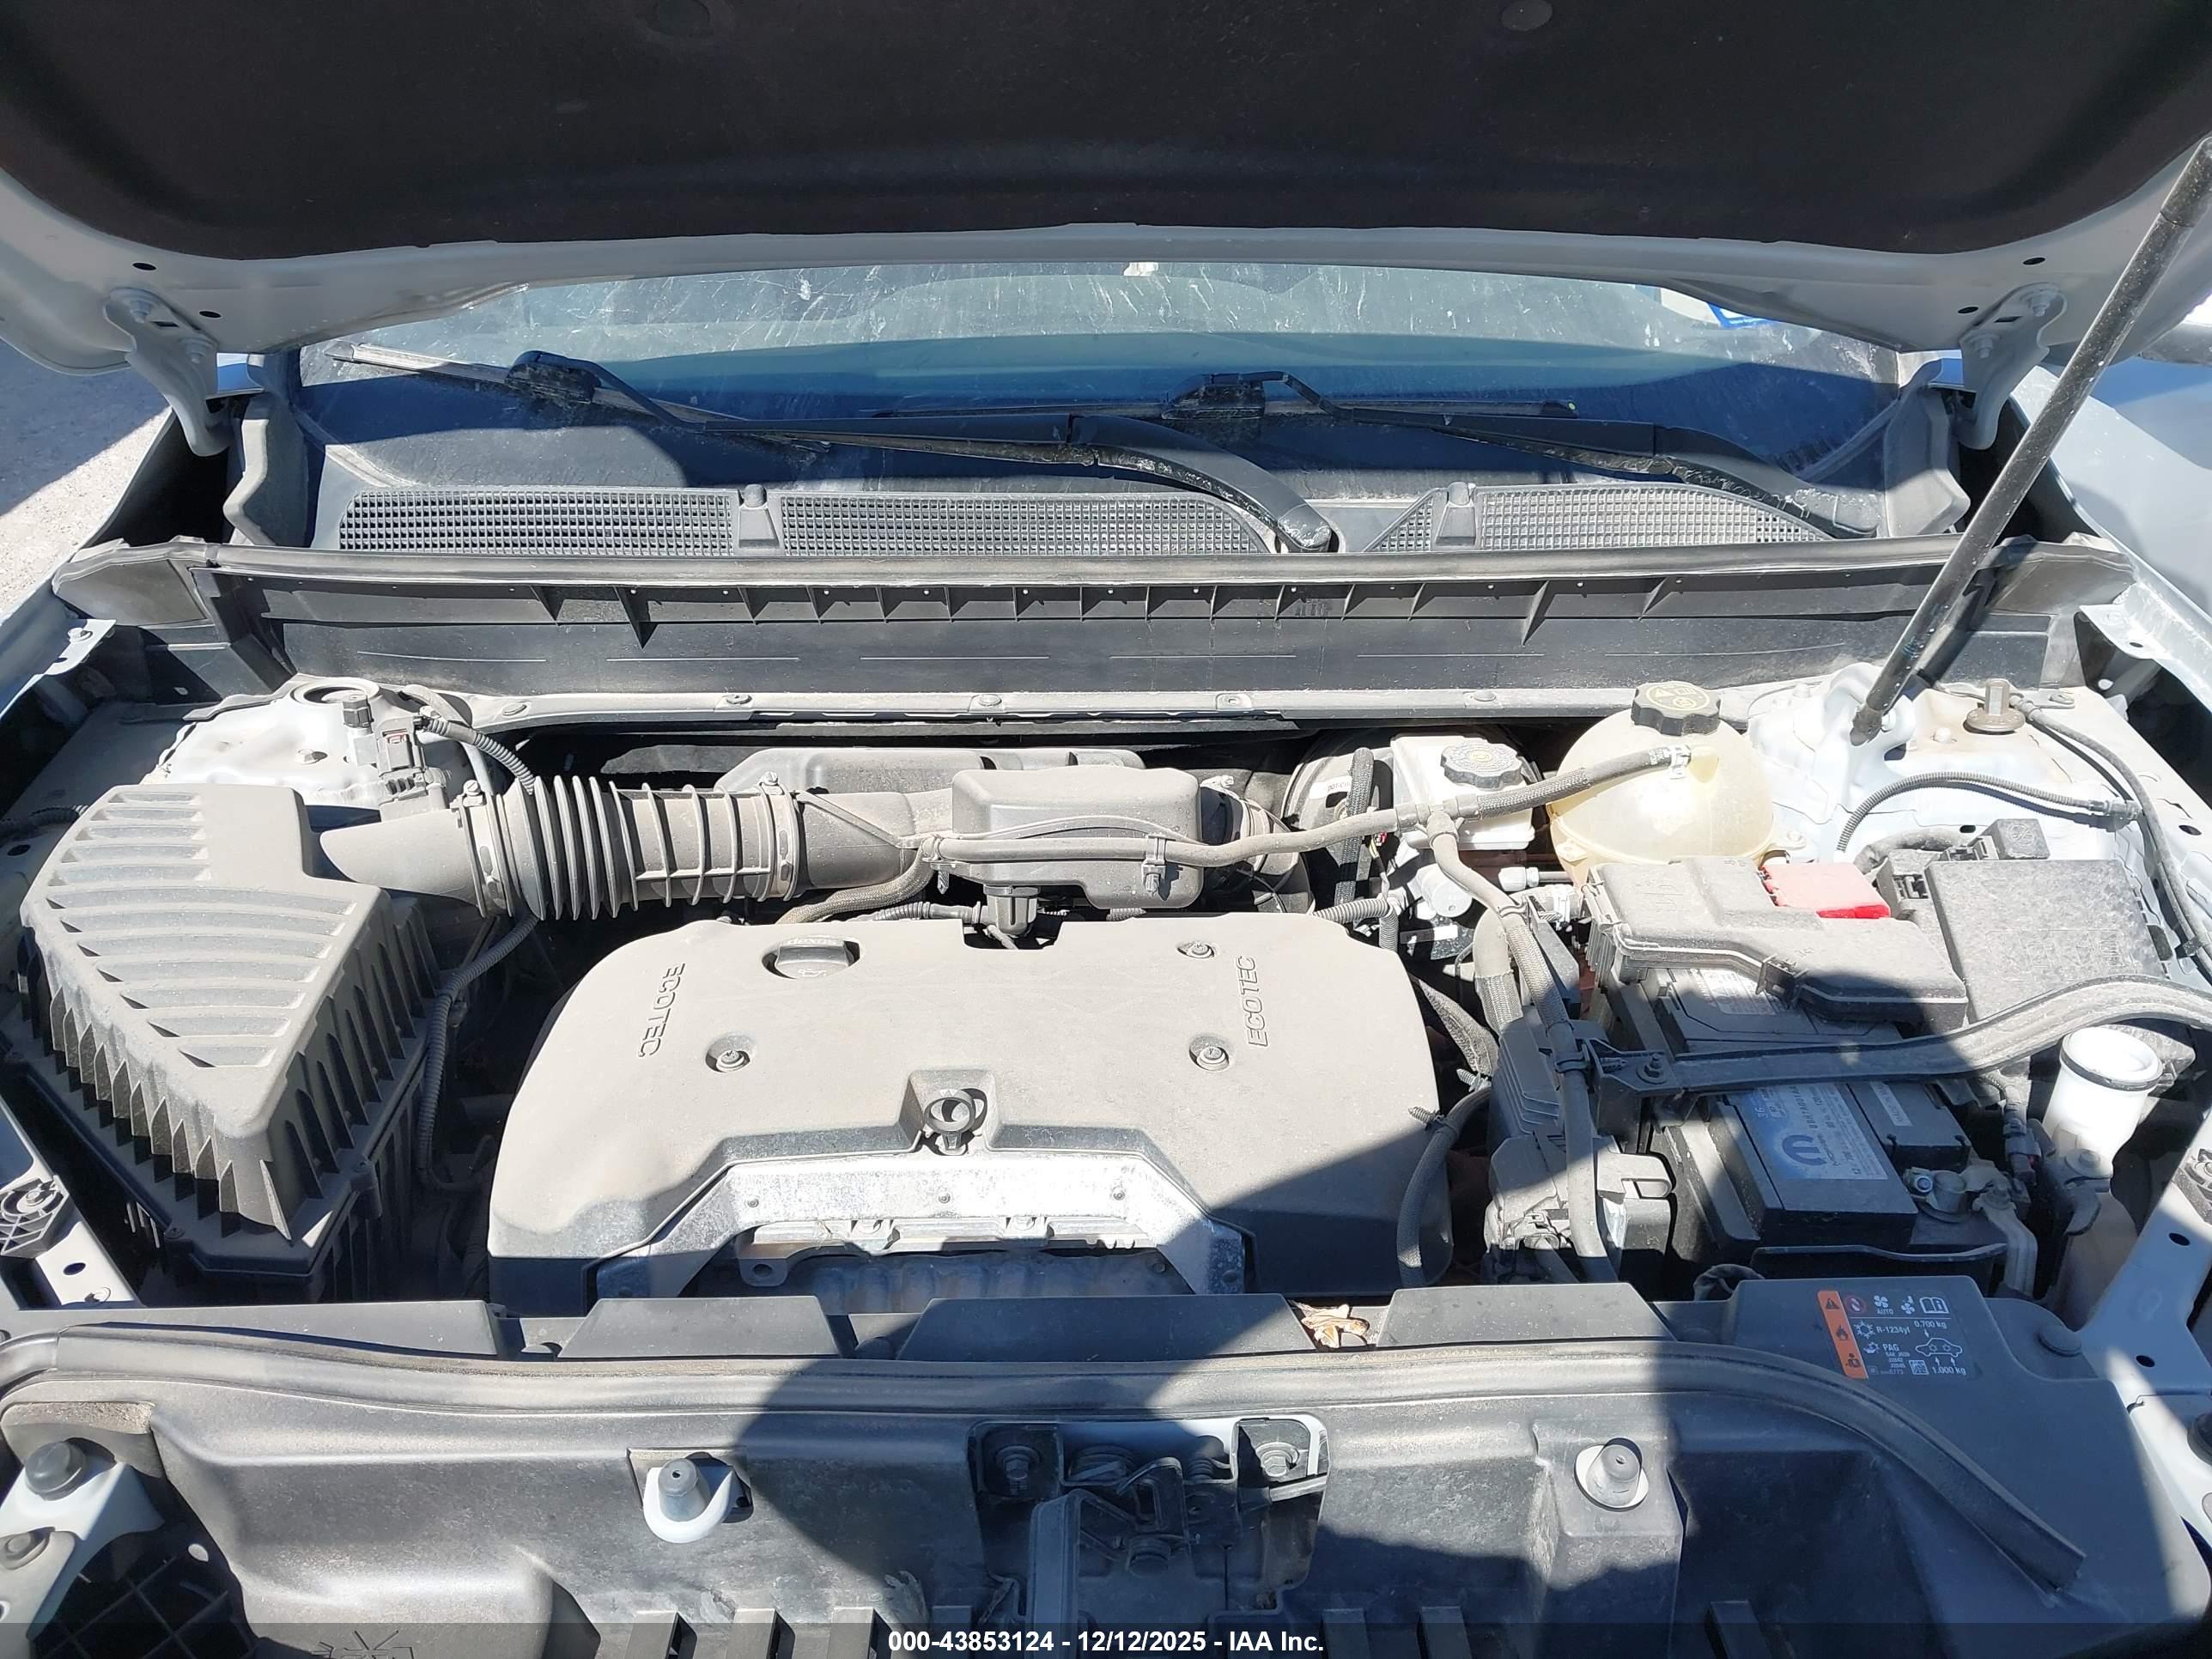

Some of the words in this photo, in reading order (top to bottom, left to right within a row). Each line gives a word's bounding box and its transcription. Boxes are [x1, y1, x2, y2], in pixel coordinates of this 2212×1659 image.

[1236, 956, 1268, 1046] ECOTEC
[639, 963, 685, 1057] ECOTEC
[1936, 1321, 1947, 1330] kg
[1882, 1343, 1899, 1352] PAG
[1932, 1366, 1954, 1375] 1.000
[1954, 1366, 1966, 1376] kg
